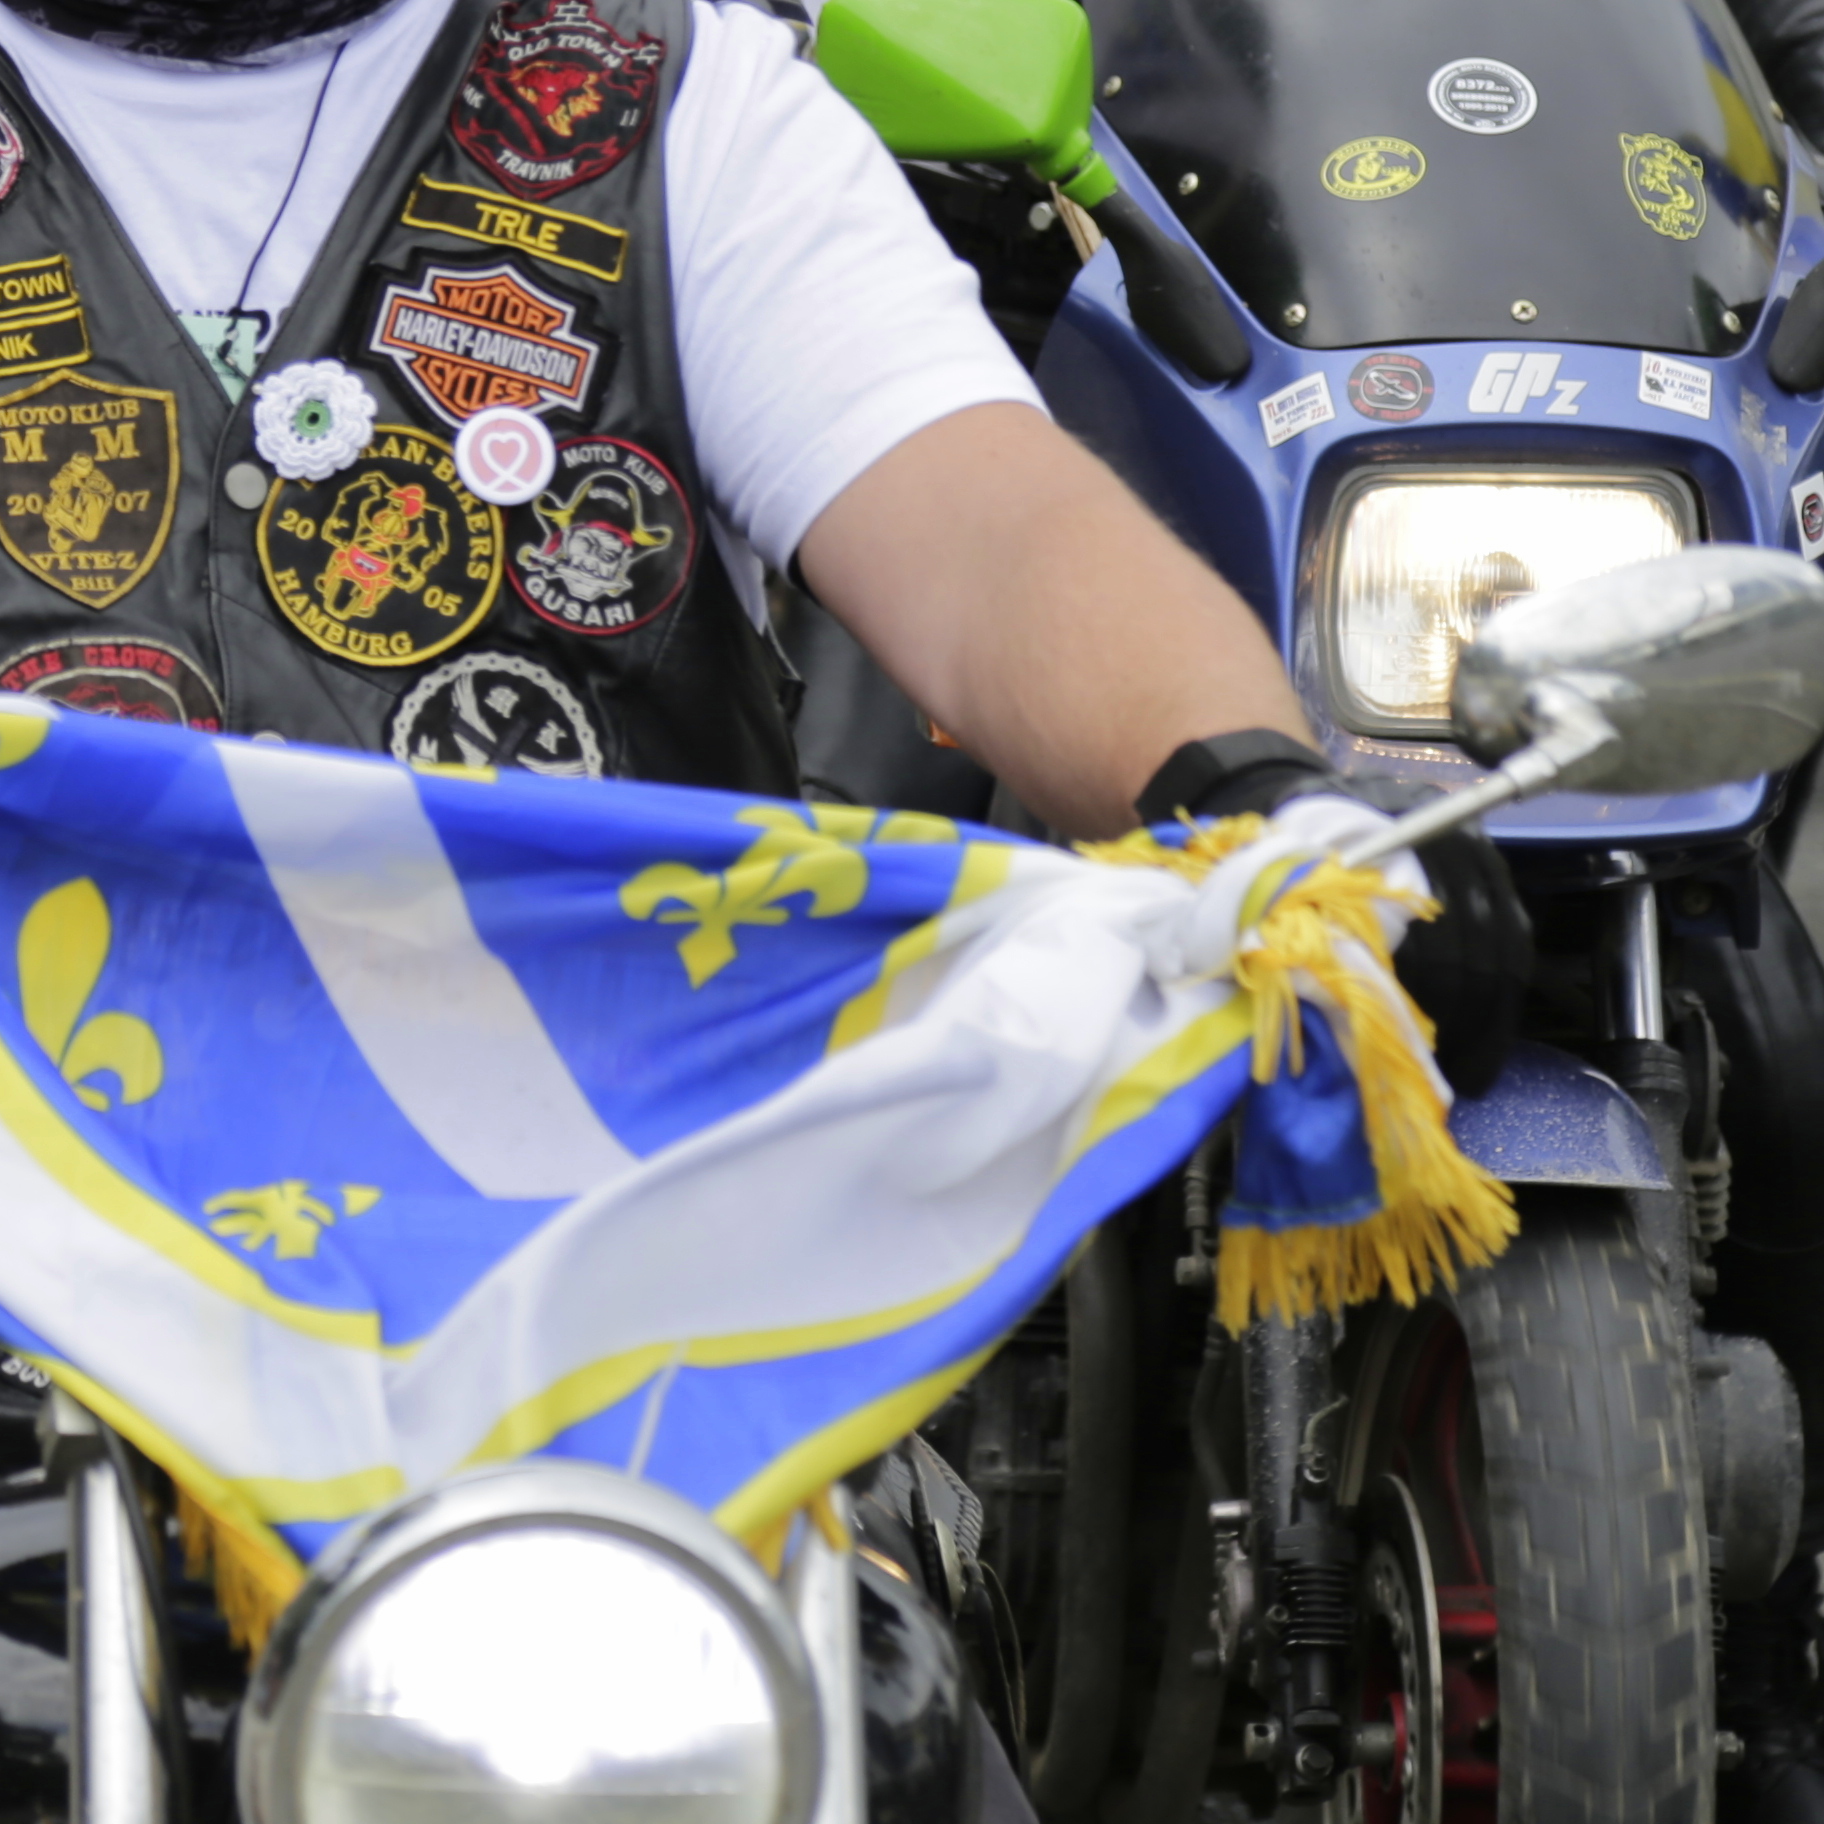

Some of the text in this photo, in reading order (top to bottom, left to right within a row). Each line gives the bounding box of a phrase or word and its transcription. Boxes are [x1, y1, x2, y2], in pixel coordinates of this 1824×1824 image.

[508, 33, 623, 69] OLD TOWN
[495, 148, 574, 181] TRAVNIK
[475, 201, 564, 252] TRLE
[446, 284, 548, 336] MOTOR
[391, 305, 578, 388] HARLEY-DAVIDSON
[425, 357, 528, 411] CYCLES
[1468, 351, 1589, 416] GPz
[69, 398, 142, 425] KLUB
[0, 427, 49, 464] M
[90, 422, 142, 462] M
[622, 453, 669, 496] KLUB
[6, 492, 44, 517] 20
[114, 489, 152, 514] 07
[276, 508, 317, 540] 20
[29, 550, 140, 572] VITEZ
[274, 567, 414, 656] HAMBURG
[422, 585, 463, 617] 05
